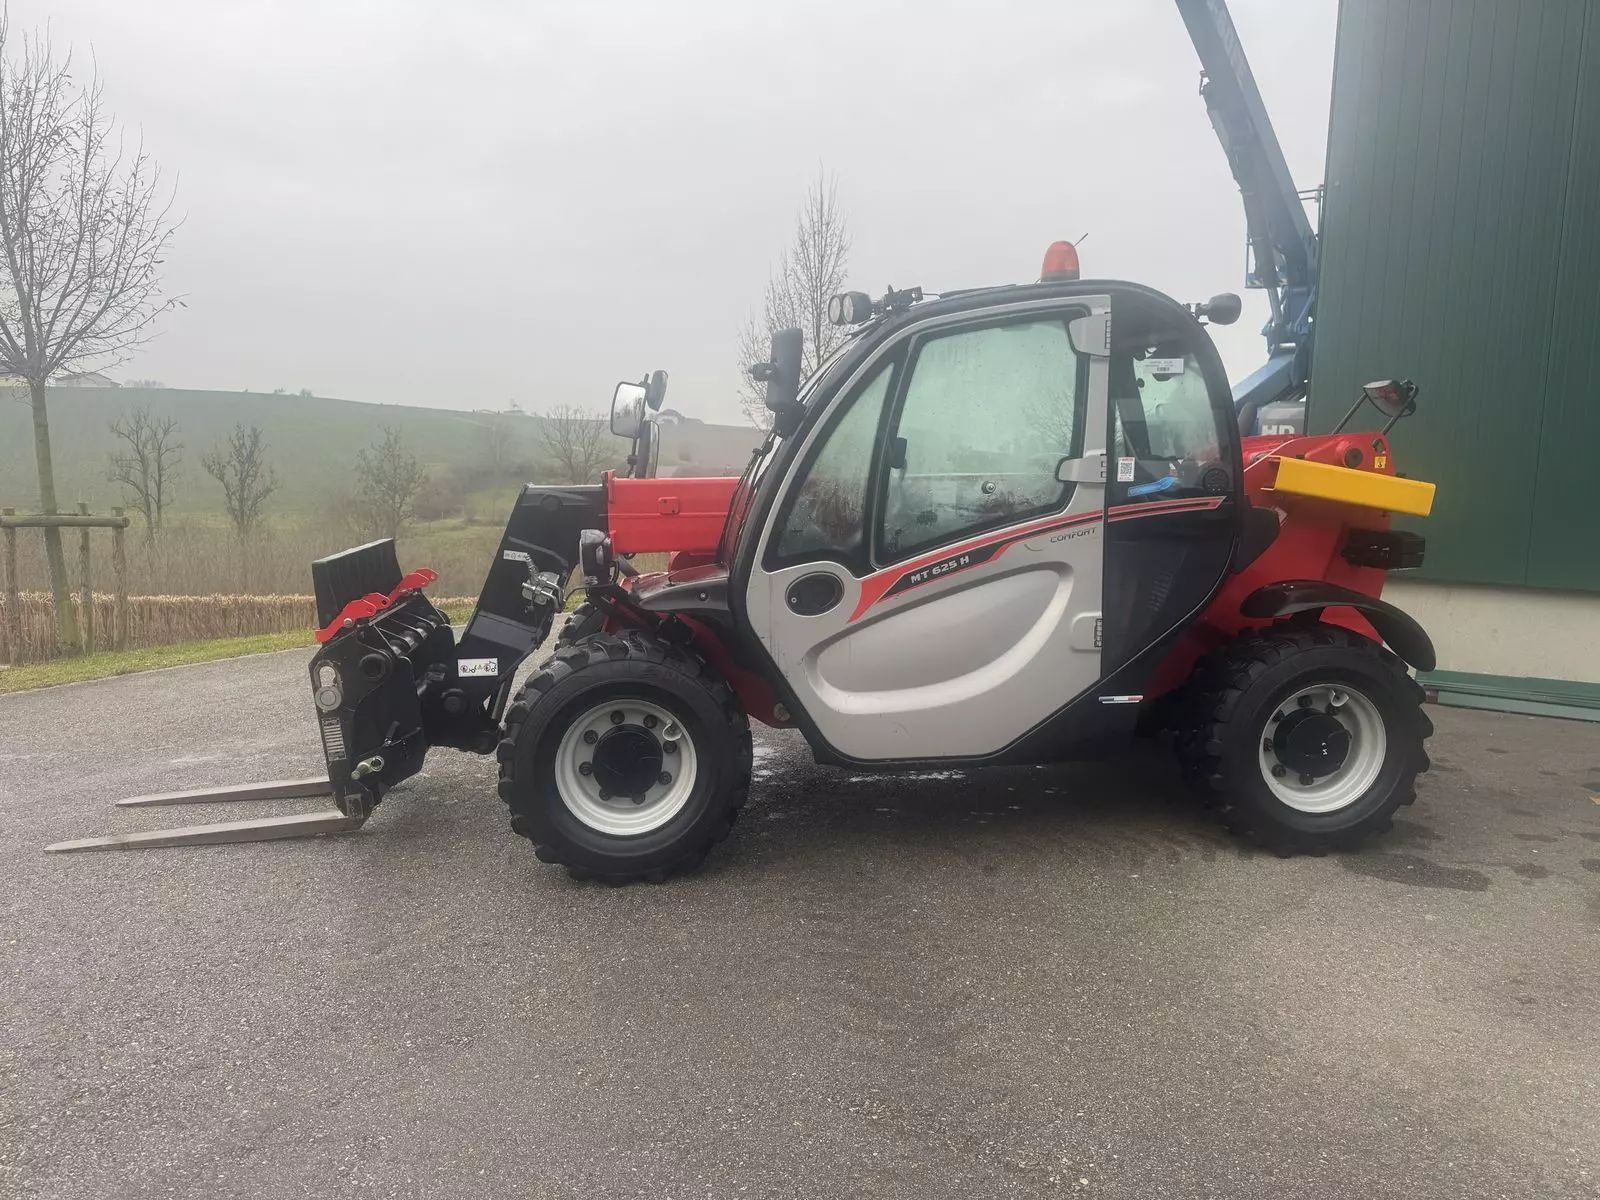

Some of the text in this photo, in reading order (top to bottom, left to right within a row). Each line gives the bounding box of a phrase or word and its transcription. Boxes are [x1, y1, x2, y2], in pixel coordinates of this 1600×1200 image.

[1050, 526, 1097, 543] COMFORT
[910, 555, 970, 584] MT 625 H
